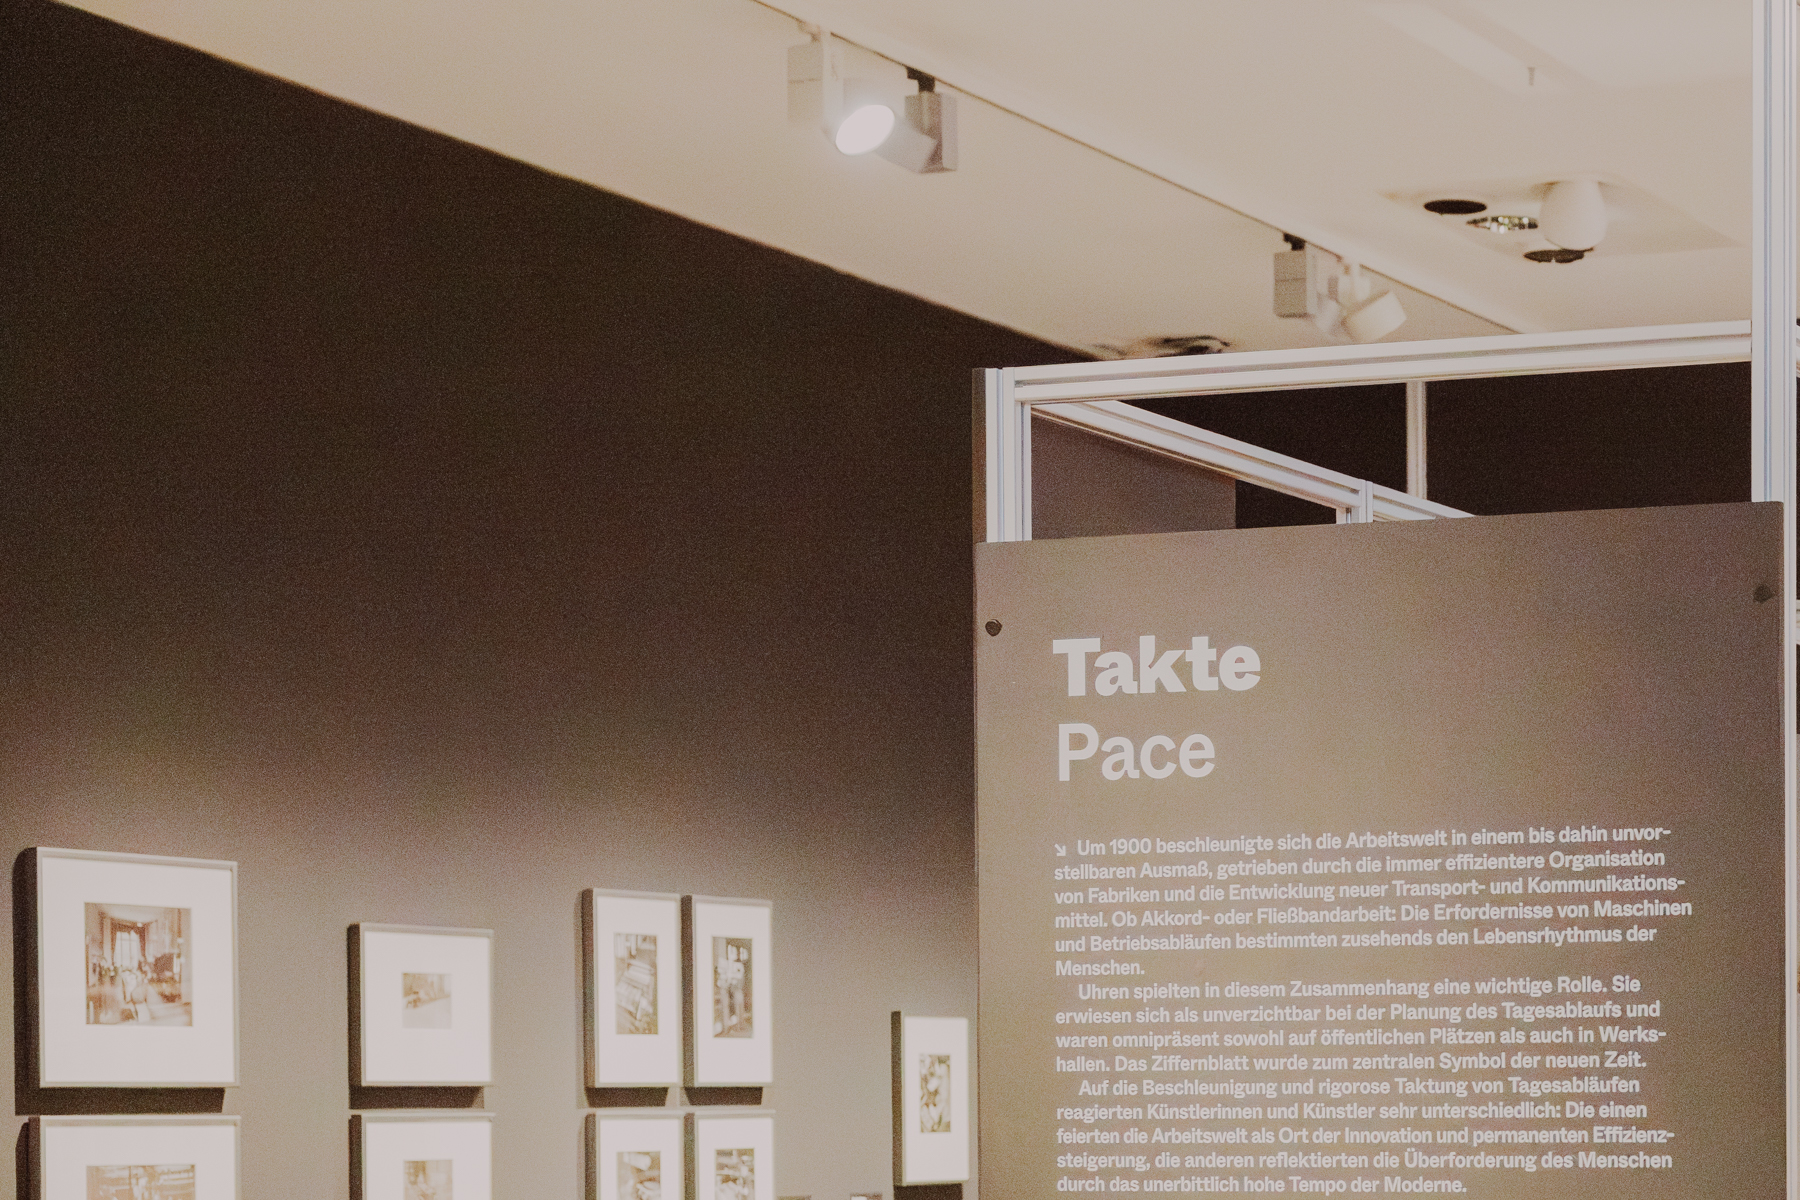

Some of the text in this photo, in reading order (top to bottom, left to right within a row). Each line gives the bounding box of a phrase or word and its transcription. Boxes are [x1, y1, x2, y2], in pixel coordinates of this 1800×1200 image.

[1052, 634, 1261, 697] Takte
[1058, 722, 1215, 781] Pace
[1076, 824, 1671, 856] Um 1900 beschleunigte sich die Arbeitswelt in einem bis dahin unvor-
[1053, 848, 1665, 880] stellbaren Ausmaß, getrieben durch die immer effizientere Organisation
[1053, 873, 1685, 904] von Fabriken und die Entwicklung neuer Transport- und Kommunikations-
[1054, 898, 1692, 928] mittel. Ob Akkord- oder Fließbandarbeit: Die Erfordernisse von Maschinen
[1054, 924, 1657, 952] und Betriebsabläufen bestimmten zusehends den Lebensrhythmus der
[1055, 958, 1145, 976] Menschen.
[1077, 974, 1640, 1003] Uhren spielten in diesem Zusammenhang eine wichtige Rolle. Sie
[1078, 1075, 1640, 1099] Auf die Beschleunigung und rigorose Taktung von Tagesabläufen
[1056, 1100, 1647, 1124] reagierten Künstlerinnen und Künstler sehr unterschiedlich: Die einen
[1056, 1175, 1467, 1196] durch das unerbittlich hohe Tempo der Moderne.
